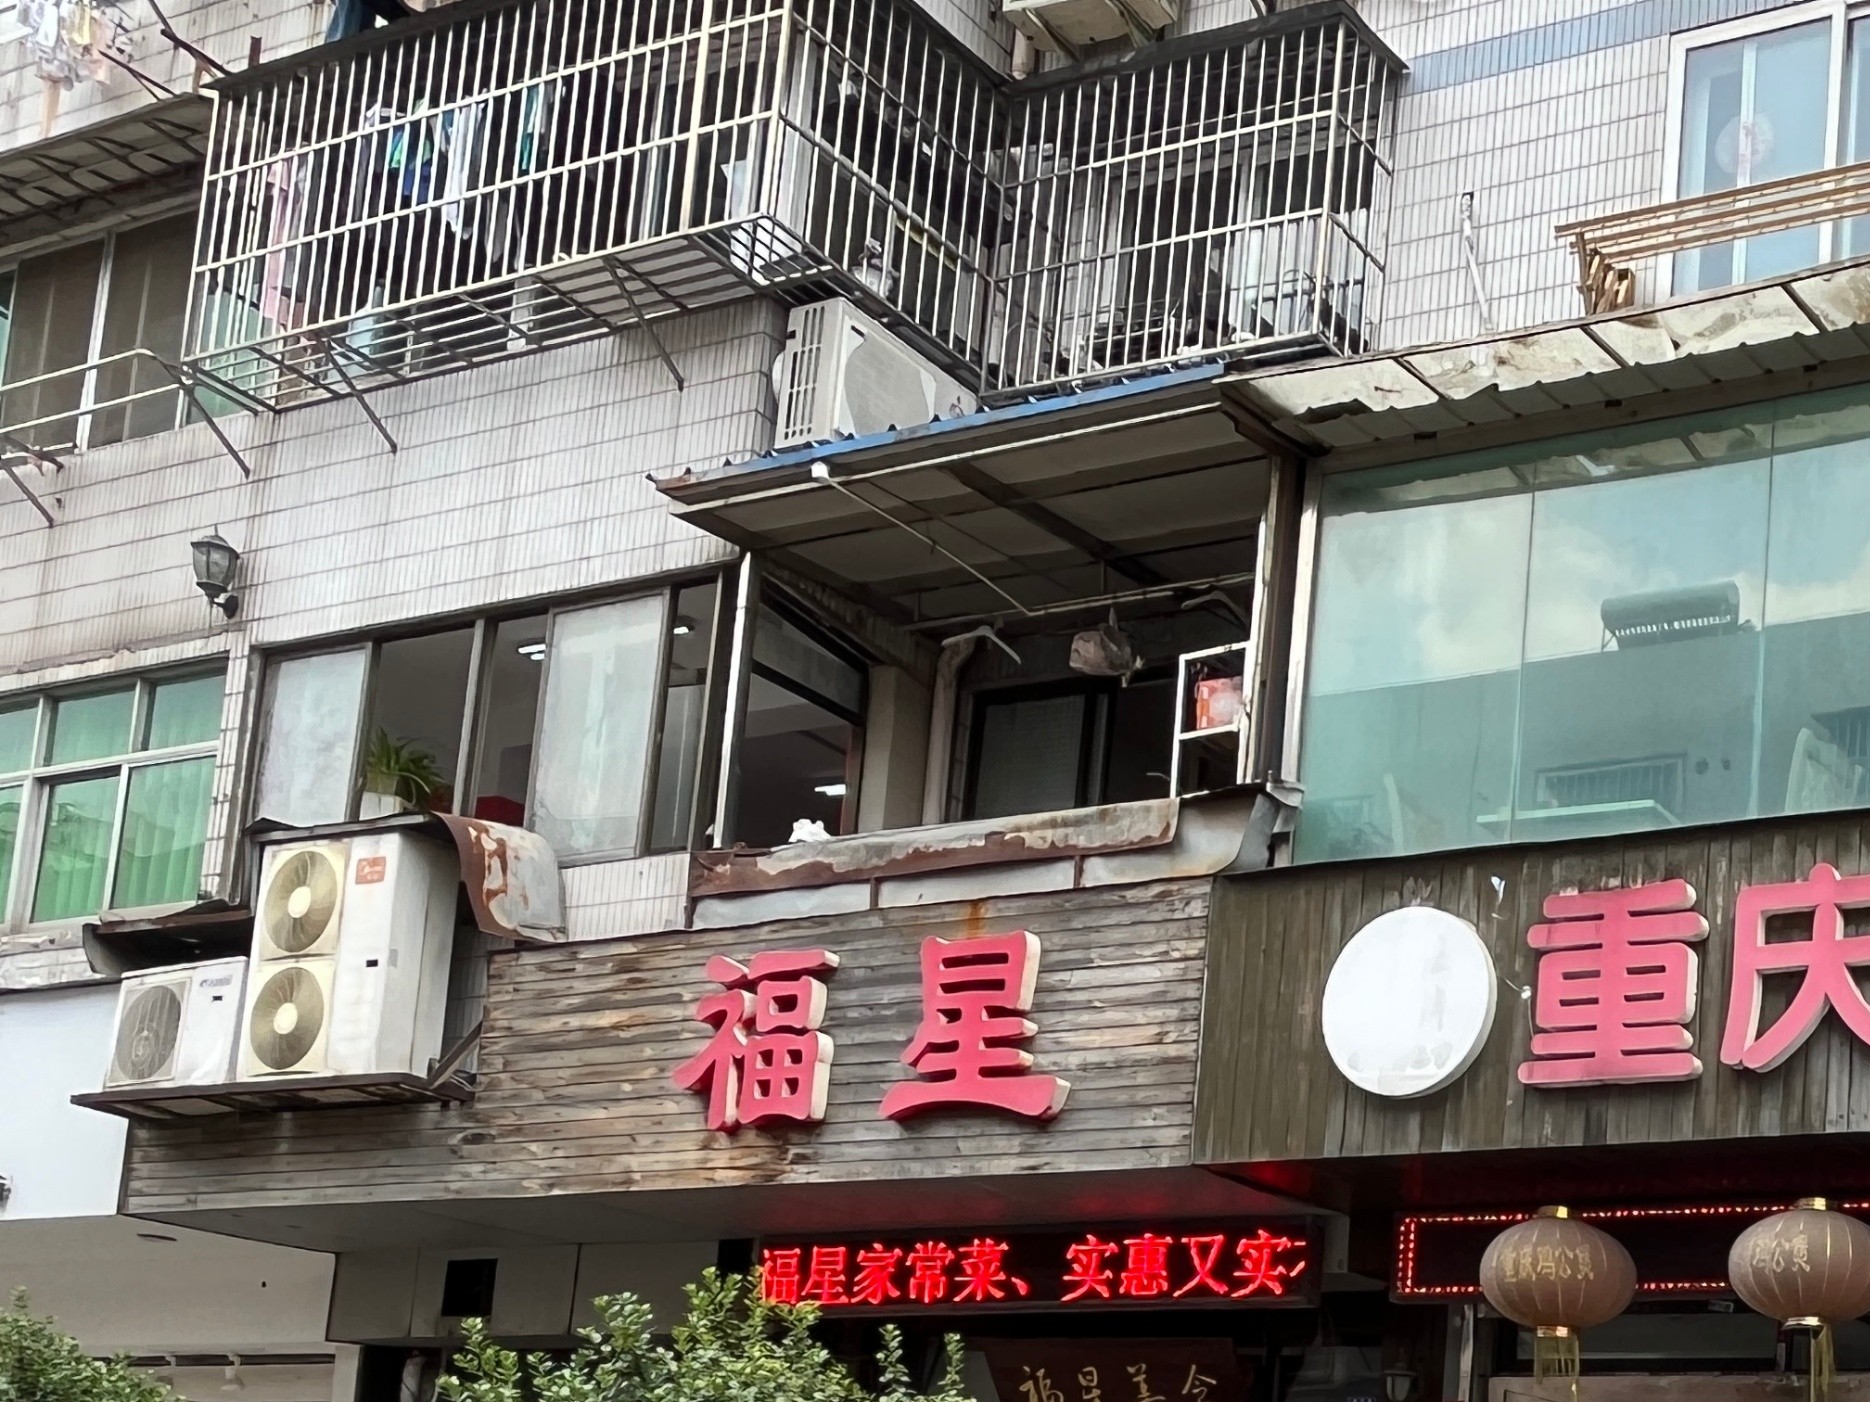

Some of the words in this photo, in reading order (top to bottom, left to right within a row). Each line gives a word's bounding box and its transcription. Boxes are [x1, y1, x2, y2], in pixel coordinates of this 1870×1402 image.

[672, 930, 1072, 1132] 福星
[763, 1230, 1306, 1305] 福星家常菜、实惠又实
